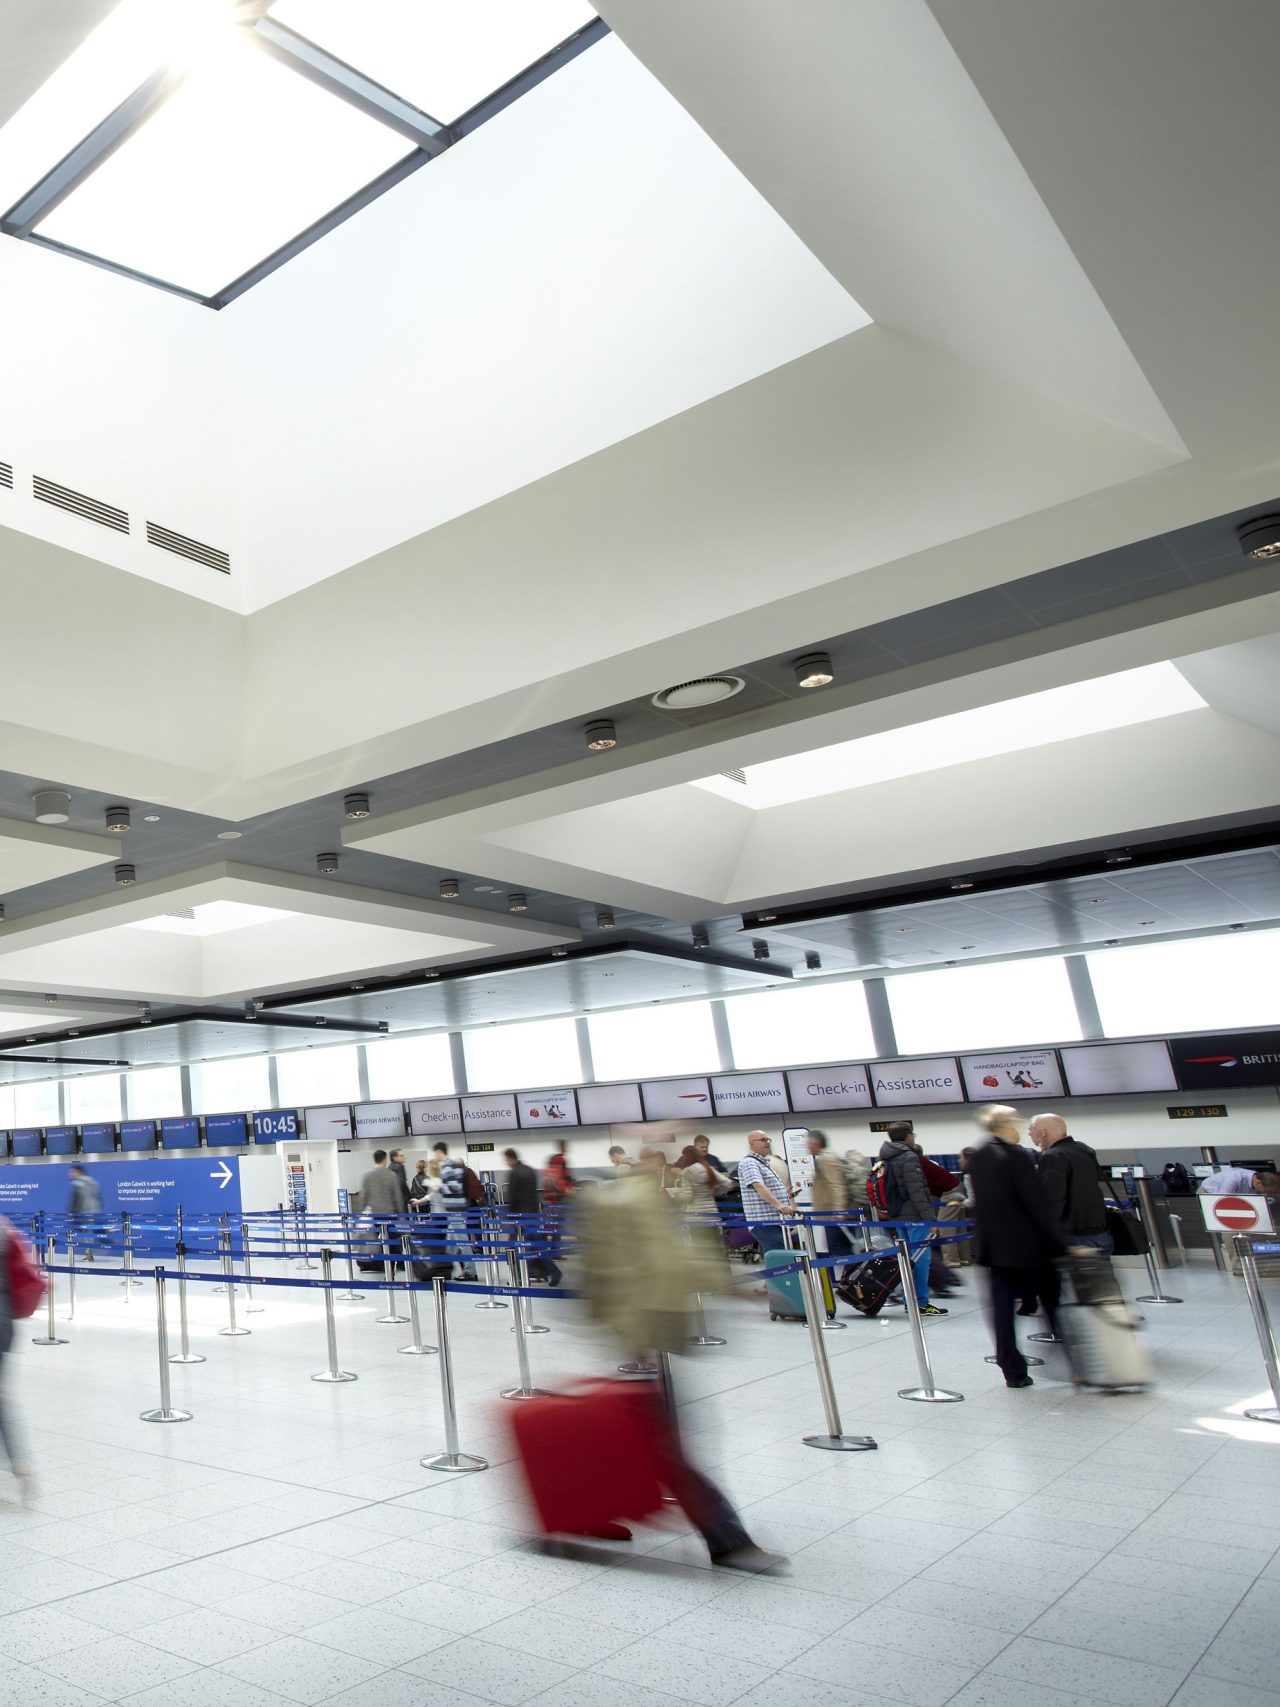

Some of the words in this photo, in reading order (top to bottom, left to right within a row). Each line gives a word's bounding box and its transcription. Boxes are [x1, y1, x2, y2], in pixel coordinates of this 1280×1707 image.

[973, 1061, 1030, 1070] HANDBAG/LAPTOP
[806, 1081, 866, 1096] Check-in
[876, 1076, 953, 1091] Assistance
[714, 1091, 746, 1100] BRITISH
[747, 1089, 782, 1098] AIRWAYS
[421, 1112, 459, 1123] Check-in
[464, 1108, 512, 1120] Assistance
[1176, 1108, 1194, 1117] 129
[1200, 1107, 1220, 1116] 130
[254, 1115, 297, 1134] 10:45
[378, 1116, 401, 1124] AIRWAYS
